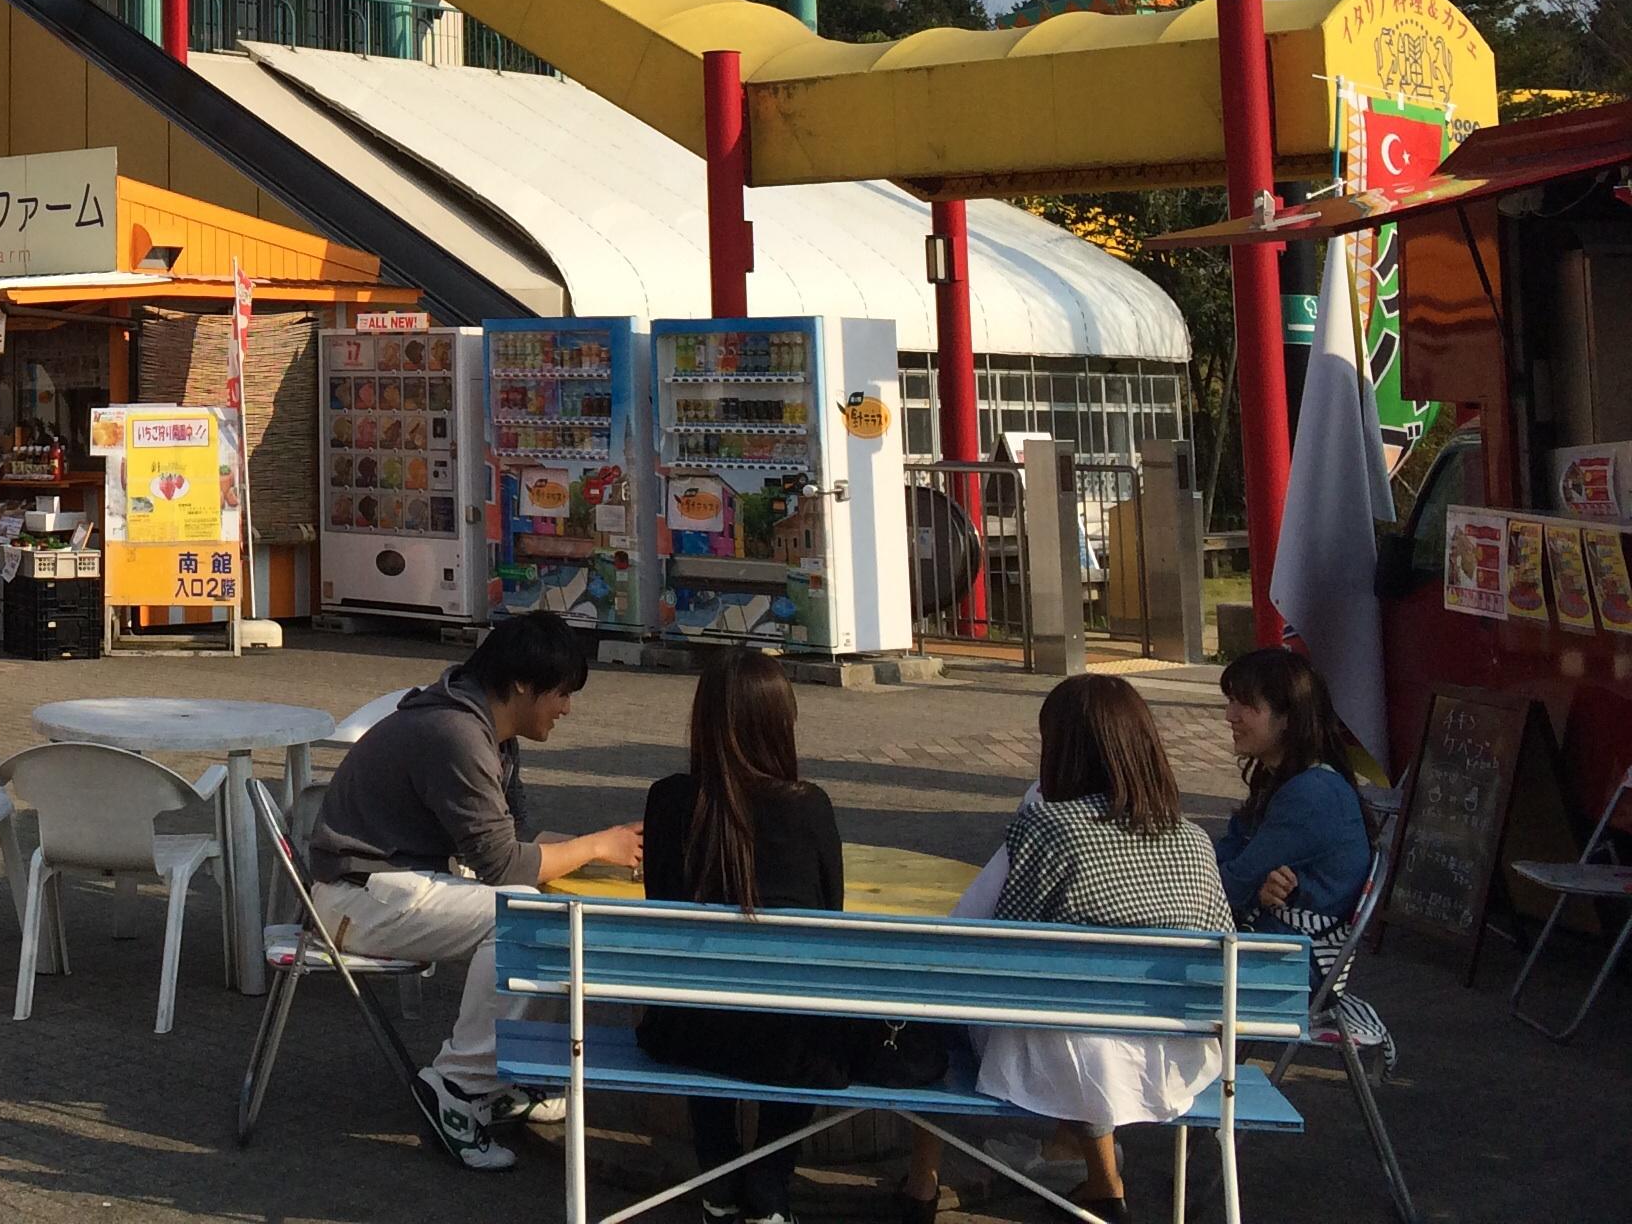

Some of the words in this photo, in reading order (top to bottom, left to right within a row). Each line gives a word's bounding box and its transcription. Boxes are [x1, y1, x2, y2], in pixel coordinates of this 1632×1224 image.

[368, 316, 388, 330] ALL
[390, 315, 417, 329] NEW!
[178, 551, 233, 575] 南館
[175, 577, 237, 599] 入口2階
